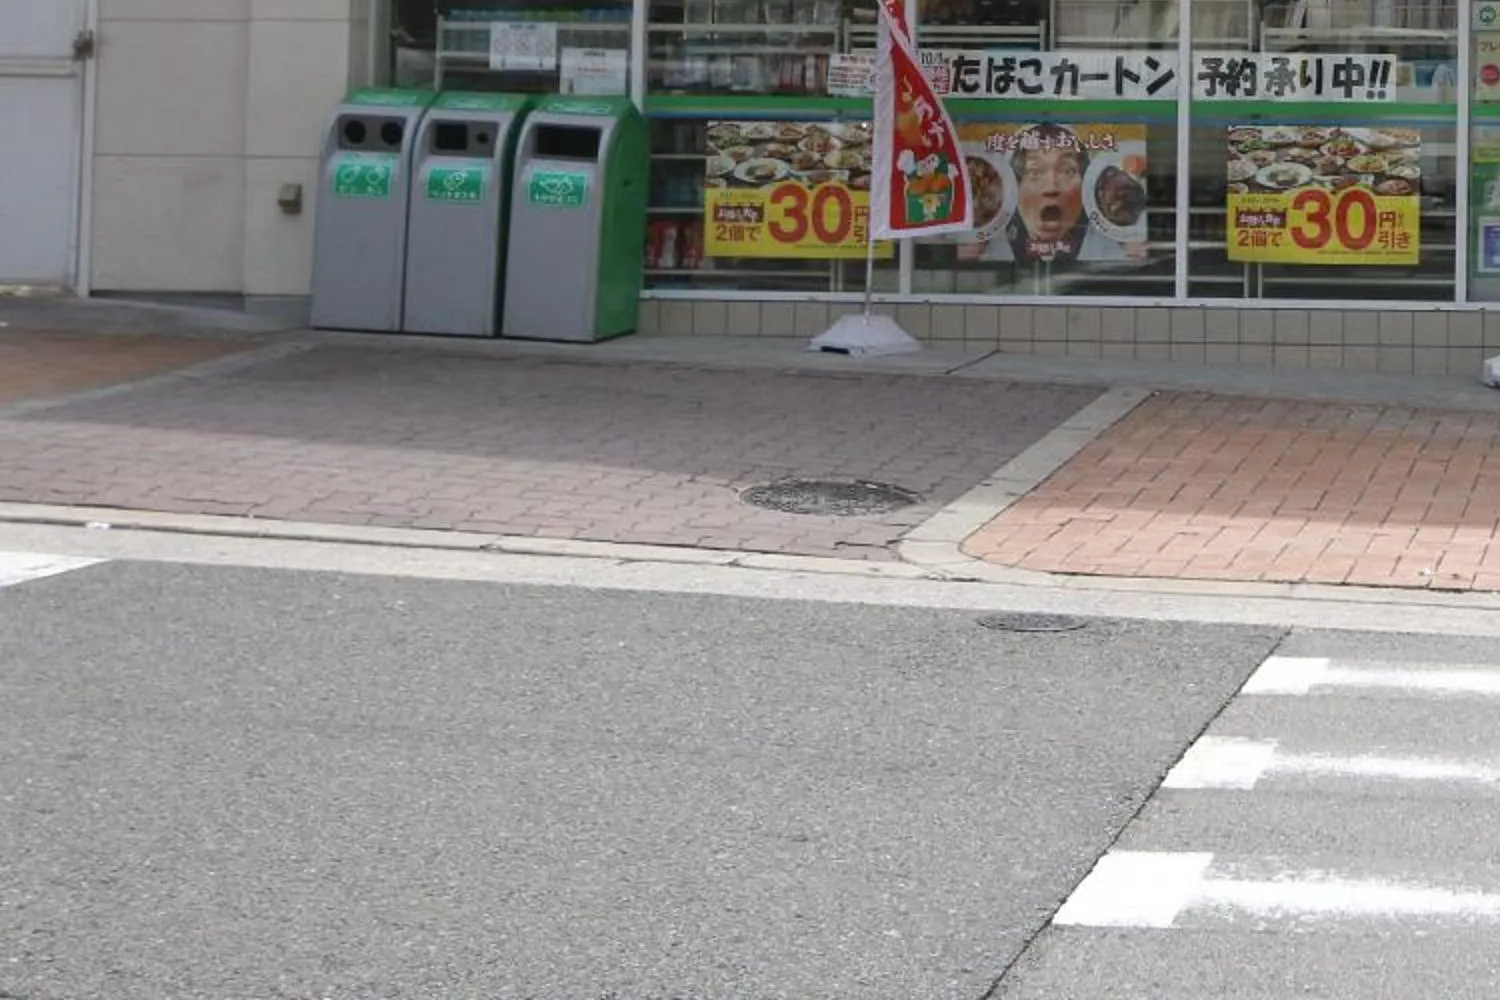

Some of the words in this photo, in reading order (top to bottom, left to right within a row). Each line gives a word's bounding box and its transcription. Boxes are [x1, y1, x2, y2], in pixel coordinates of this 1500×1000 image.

[951, 54, 1175, 97] たばこカートン
[1197, 56, 1392, 100] 予約承り中!!
[768, 183, 852, 244] 30
[1289, 188, 1378, 251] 30
[1236, 229, 1284, 248] 2個で
[1377, 231, 1412, 249] 引き
